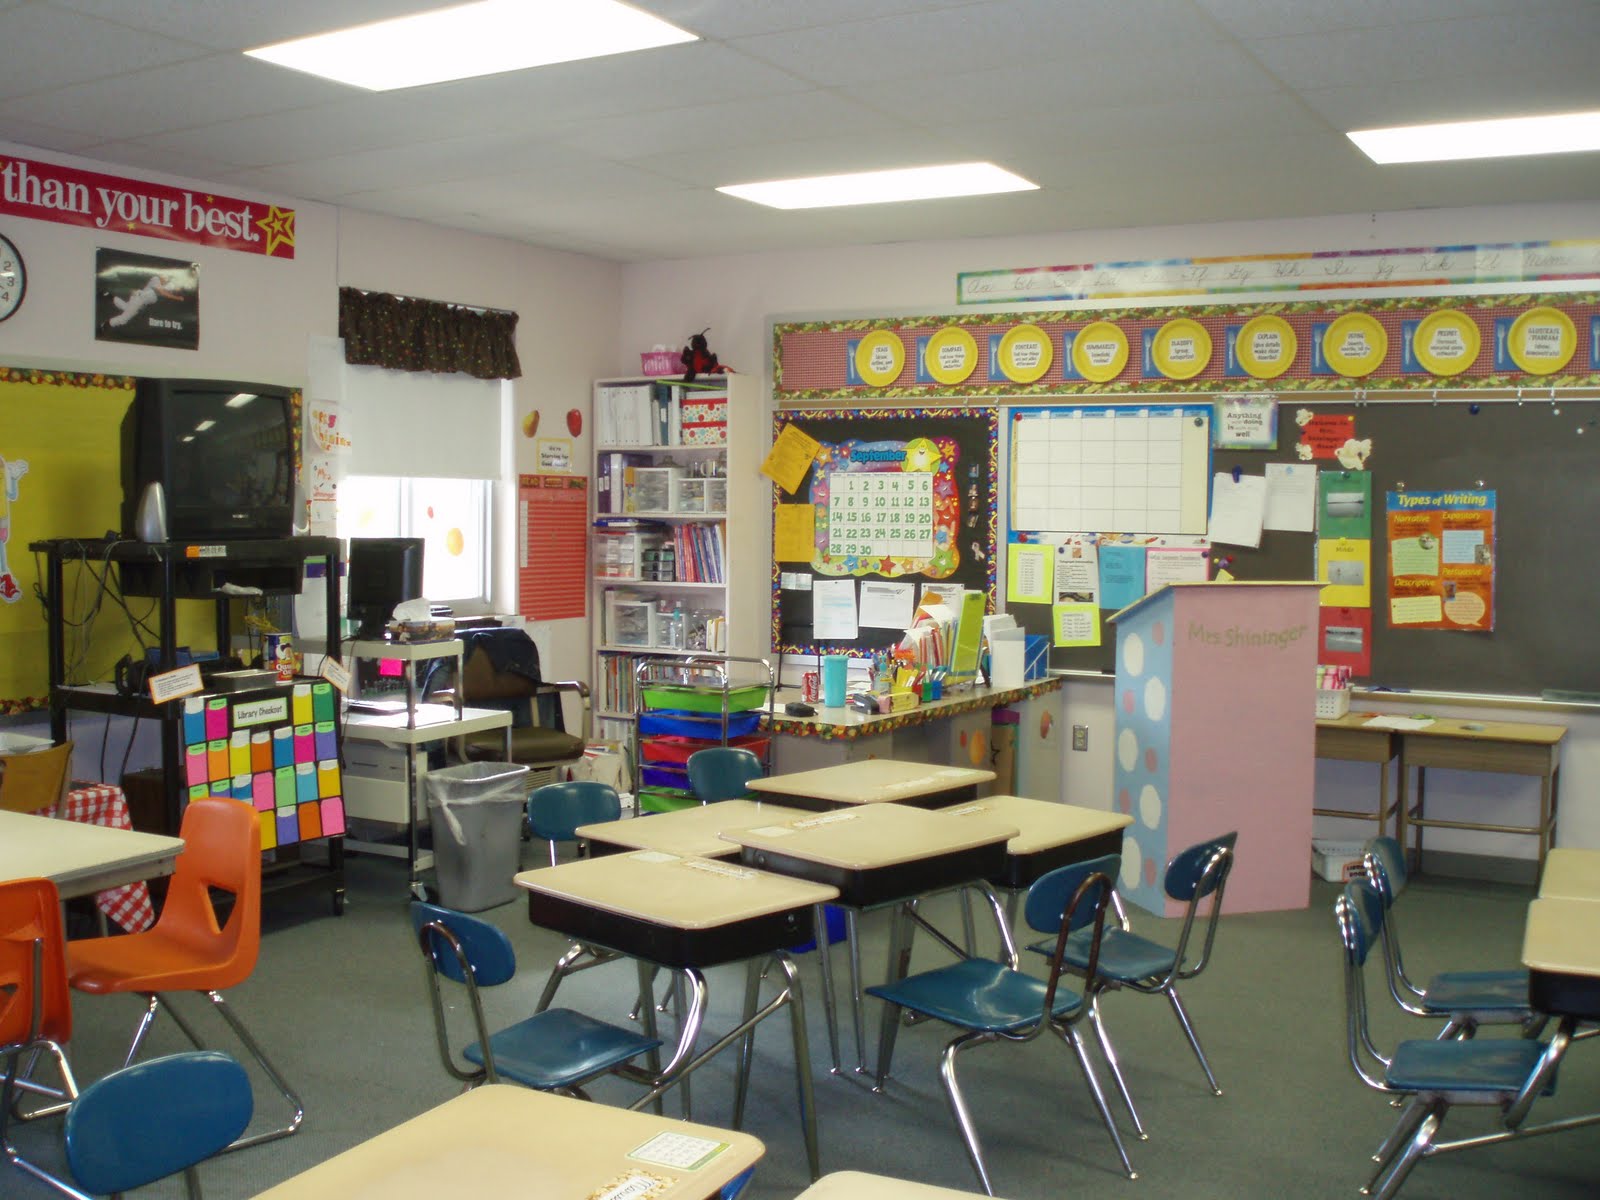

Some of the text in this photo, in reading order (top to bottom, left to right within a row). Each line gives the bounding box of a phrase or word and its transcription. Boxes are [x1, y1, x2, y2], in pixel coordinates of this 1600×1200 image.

[1, 162, 259, 242] than your best.
[4, 261, 12, 270] 2
[7, 277, 15, 287] 3
[1, 291, 9, 302] 4
[850, 449, 907, 465] September
[849, 480, 929, 491] 1 2 3 4 5 6
[834, 497, 931, 507] 7 8 9 10 11 12 13
[1398, 493, 1487, 507] Types of Writing
[832, 513, 932, 524] 14 15 16 17 18 19 20
[833, 529, 932, 540] 21 22 23 24 25 26 27
[831, 544, 872, 556] 28 29 30
[237, 704, 283, 720] Library Checkout
